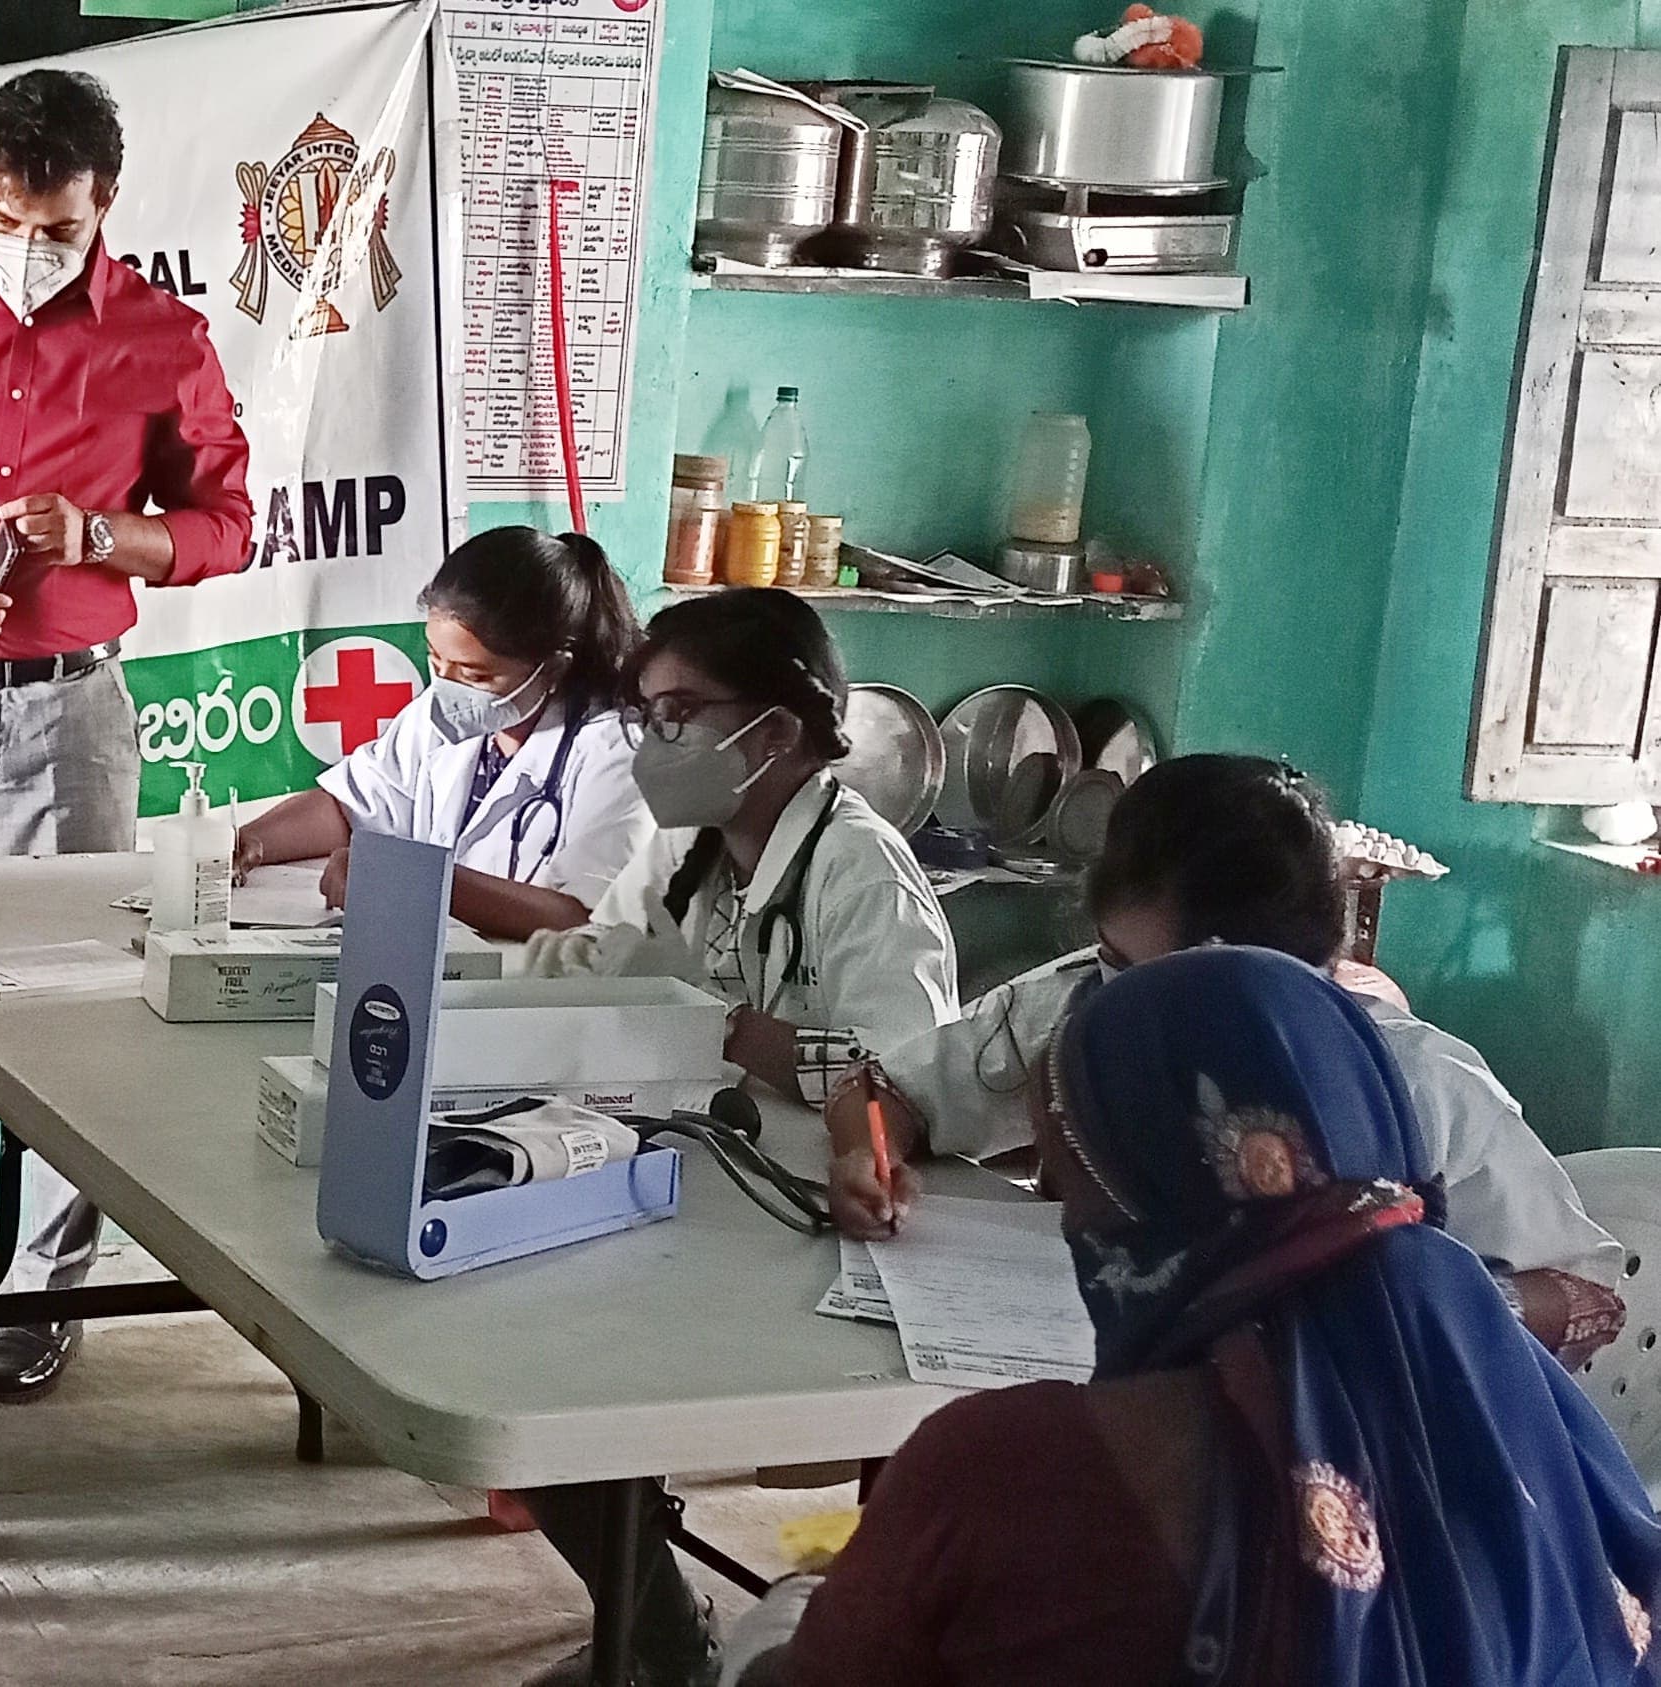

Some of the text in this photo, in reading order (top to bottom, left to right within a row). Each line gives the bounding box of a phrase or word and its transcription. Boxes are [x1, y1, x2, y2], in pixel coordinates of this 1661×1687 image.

[264, 154, 303, 213] JEEYAR
[266, 234, 304, 285] MEDIC
[140, 676, 281, 763] బిరం
[584, 1092, 633, 1105] Diamond
